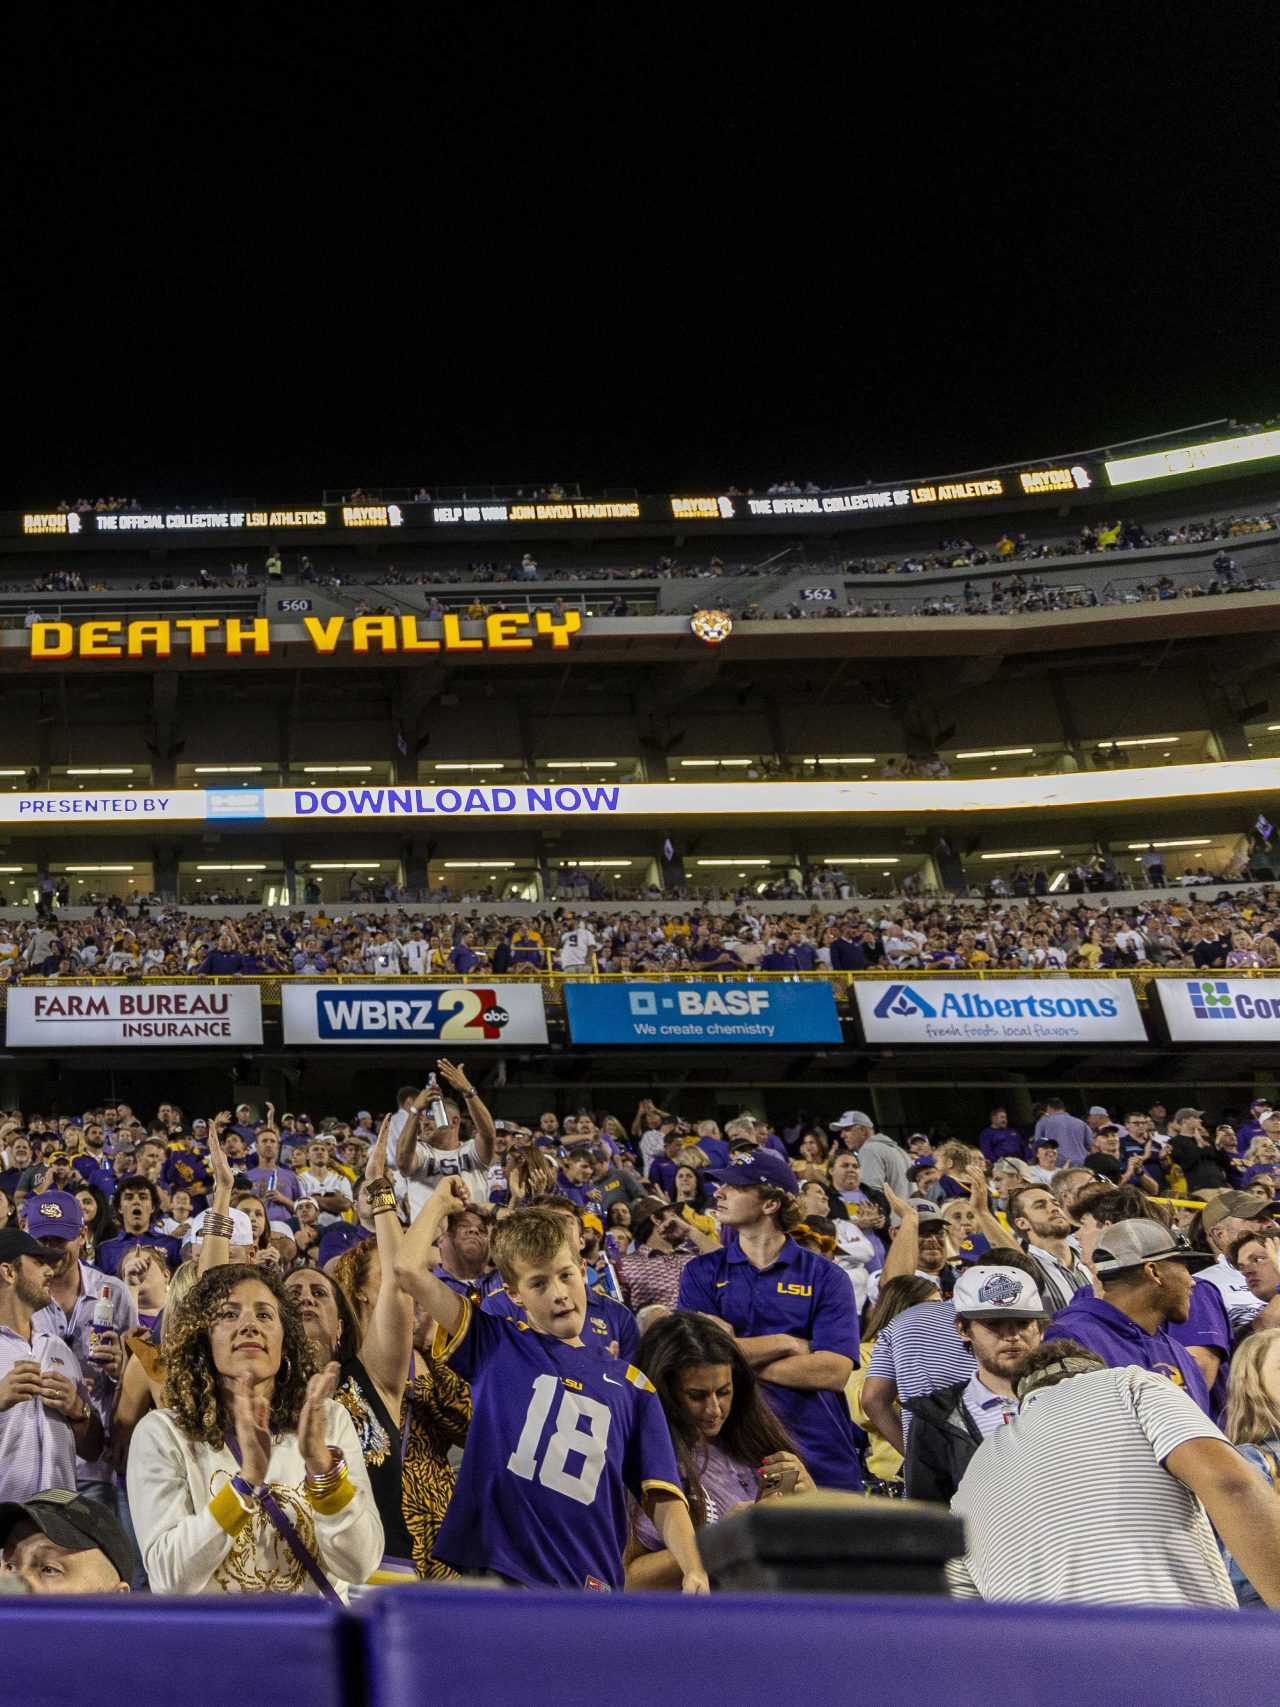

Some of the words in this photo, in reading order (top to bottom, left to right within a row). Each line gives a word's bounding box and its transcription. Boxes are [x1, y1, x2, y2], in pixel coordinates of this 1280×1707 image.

[748, 500, 772, 514] THE
[823, 492, 893, 511] COLLECTIVE
[911, 488, 935, 503] LSU
[938, 481, 1002, 501] ATHLETICS
[24, 514, 66, 527] BAYOU
[96, 516, 117, 529] THE
[119, 515, 164, 529] OFFICIAL
[166, 514, 229, 528] COLLECTIVE
[230, 513, 244, 527] OF
[246, 513, 267, 527] LSU
[270, 511, 326, 526] ATHLETICS
[344, 508, 386, 521] BAYOU
[510, 506, 535, 520] JOIN
[574, 504, 639, 518] TRADITIONS
[804, 589, 832, 600] 562
[282, 600, 308, 611] 560
[30, 617, 272, 659] DEATH
[304, 611, 582, 653] VALLEY
[19, 798, 137, 814] PRESENTED
[143, 797, 169, 812] BY
[293, 787, 518, 814] DOWNLOAD
[526, 786, 620, 812] NOW
[35, 995, 110, 1016] FARM
[119, 993, 229, 1015] BUREAU
[678, 990, 769, 1016] BASF
[941, 992, 1118, 1018] Albertsons
[323, 1000, 435, 1030] WBRZ
[438, 989, 485, 1039] 2
[483, 1010, 509, 1023] abc
[122, 1022, 231, 1037] INSURANCE
[634, 1024, 657, 1035] We
[660, 1025, 704, 1035] create
[707, 1023, 775, 1037] chemistry
[926, 1024, 962, 1038] fresh
[1002, 1024, 1032, 1036] local
[427, 1154, 471, 1176] LSU
[777, 1282, 812, 1297] LSU
[507, 1374, 612, 1505] 18
